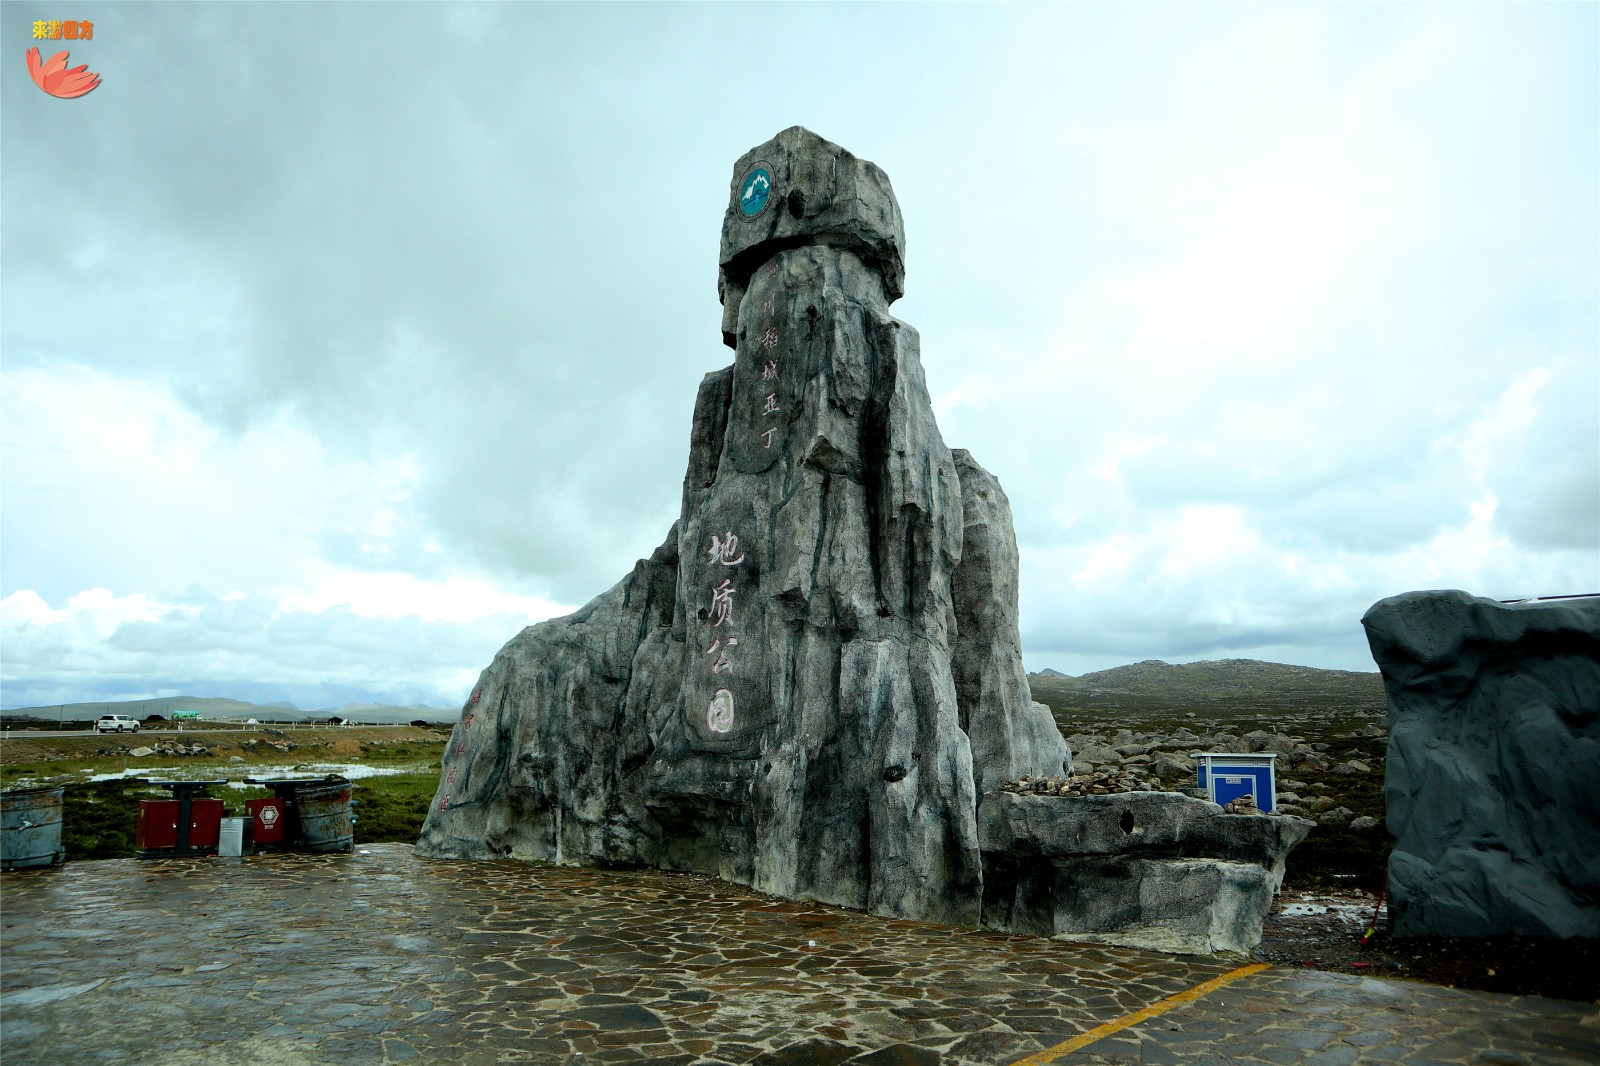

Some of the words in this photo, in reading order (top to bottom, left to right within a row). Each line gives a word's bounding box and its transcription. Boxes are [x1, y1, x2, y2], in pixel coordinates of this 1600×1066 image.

[761, 263, 780, 449] 四川稻城亚丁
[706, 531, 745, 733] 地质公园
